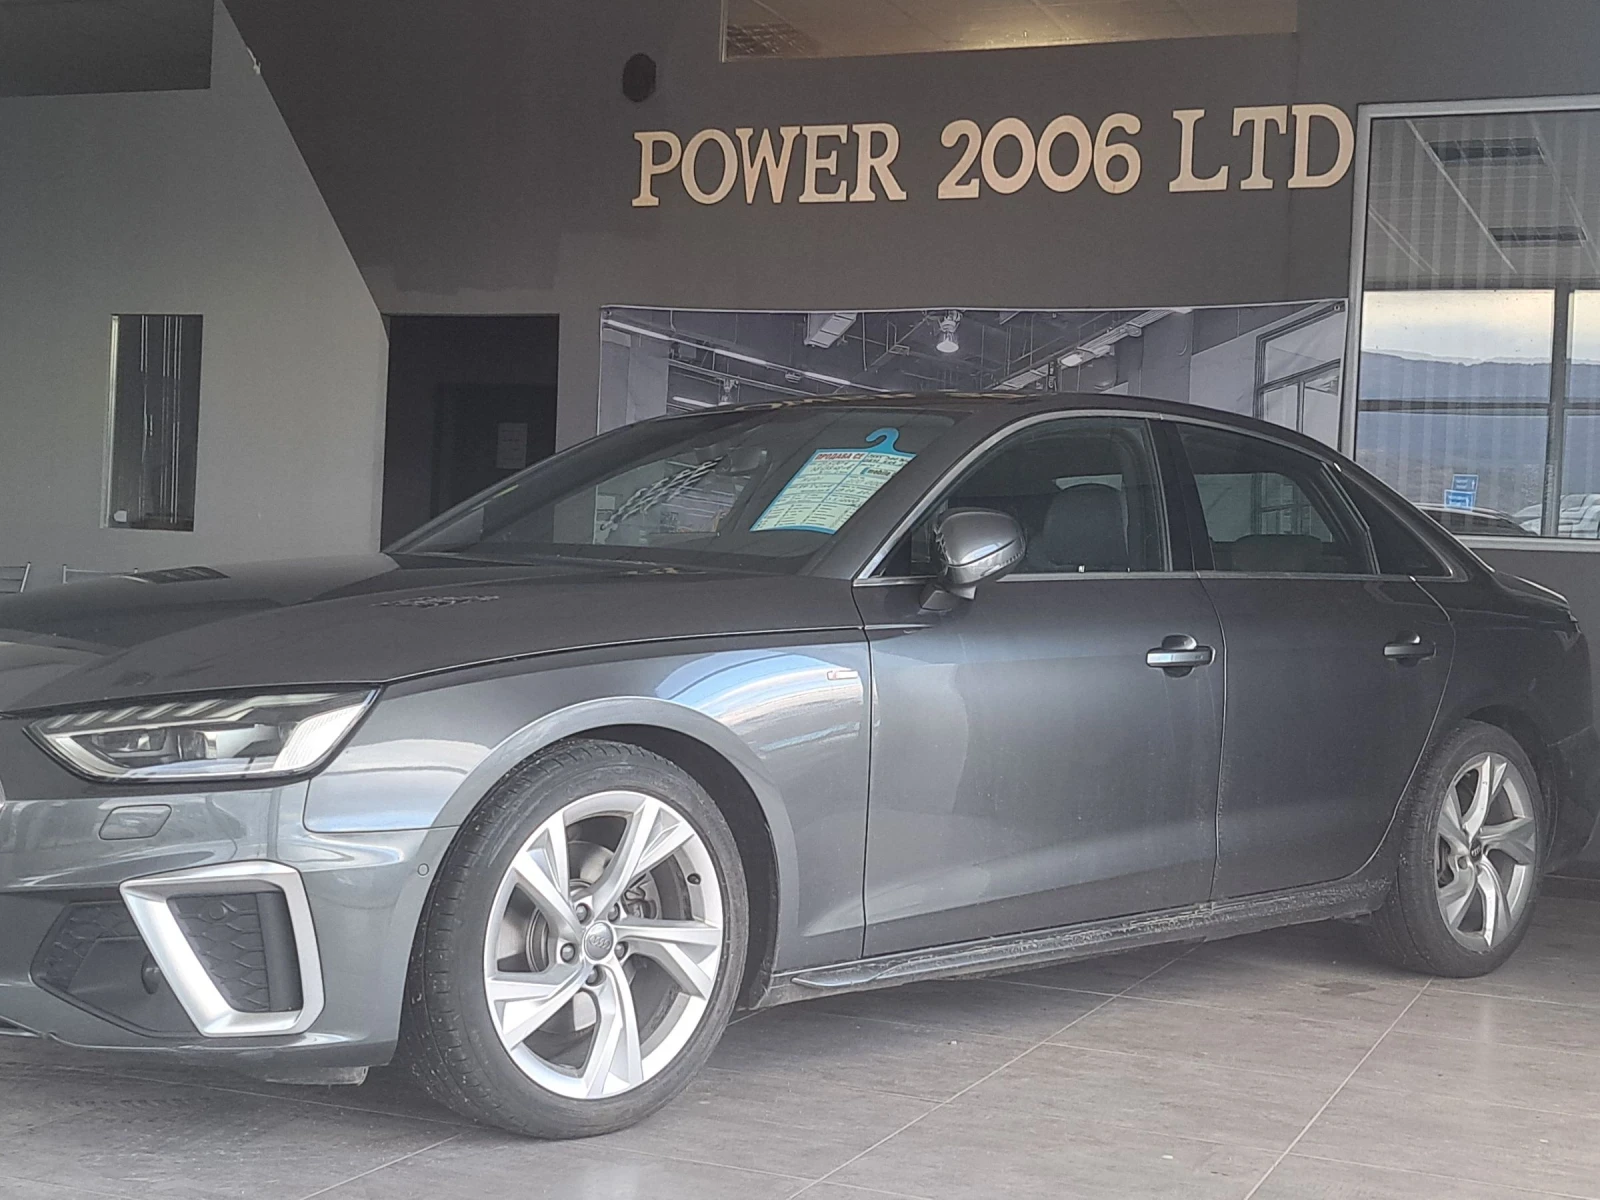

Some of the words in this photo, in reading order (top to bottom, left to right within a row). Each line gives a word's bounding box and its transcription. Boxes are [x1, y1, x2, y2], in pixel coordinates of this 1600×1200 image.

[631, 122, 907, 206] POWER
[937, 112, 1141, 199] 2006
[1168, 103, 1355, 193] LTD
